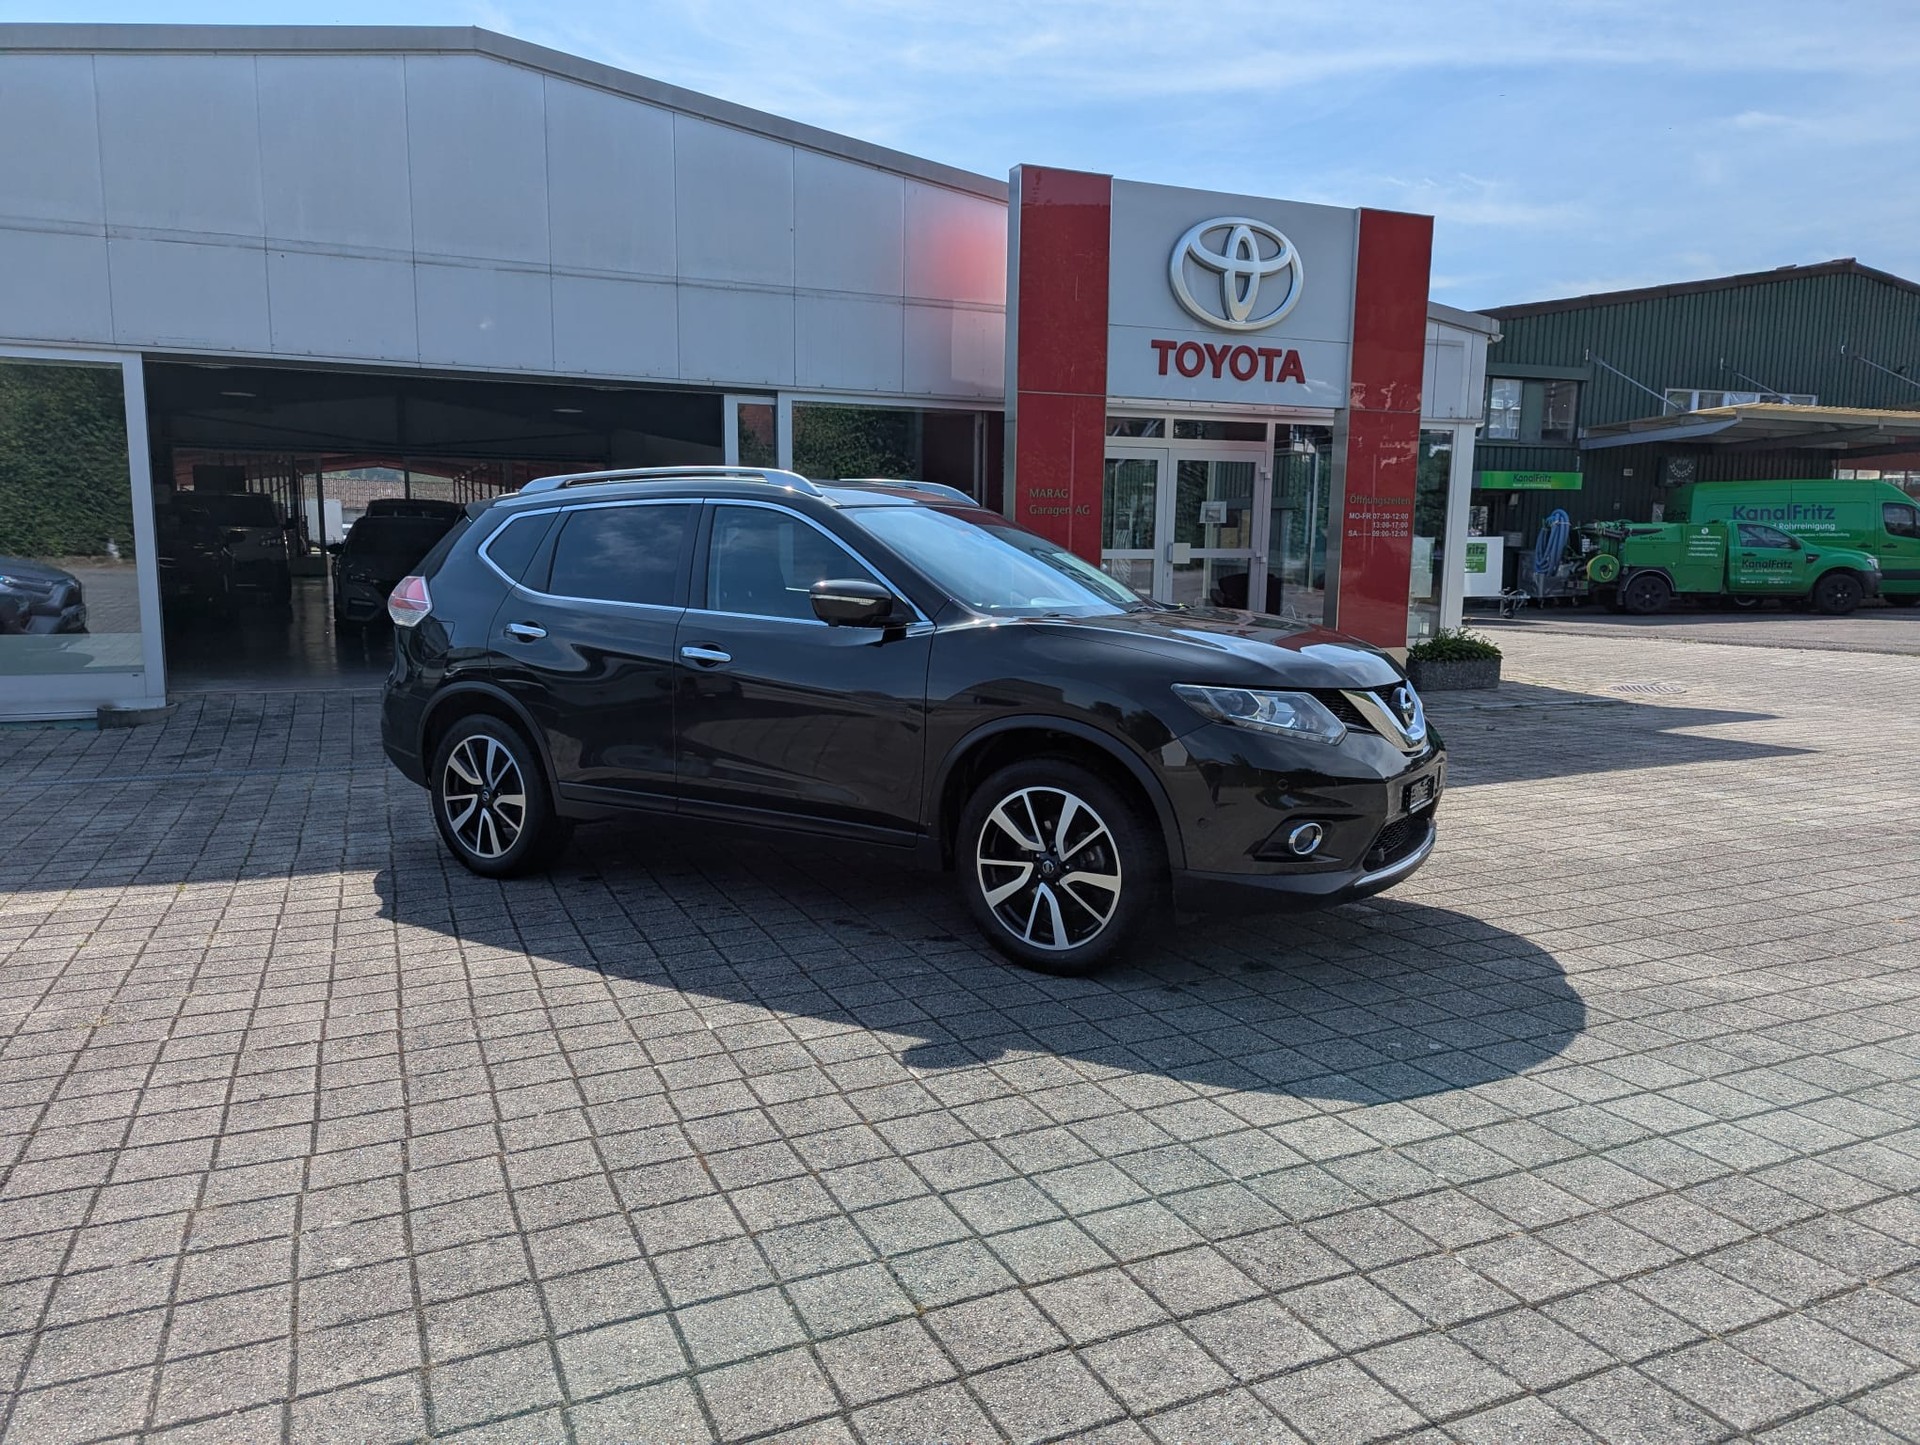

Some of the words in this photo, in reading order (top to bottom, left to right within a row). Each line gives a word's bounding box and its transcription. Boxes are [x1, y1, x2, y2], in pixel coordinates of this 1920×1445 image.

[1151, 339, 1306, 384] TOYOTA
[1512, 473, 1552, 483] KanalFritz
[1029, 488, 1069, 499] MARAG
[1029, 504, 1072, 518] Garagen
[1075, 504, 1090, 515] AG
[1349, 512, 1371, 520] MO-FR
[1732, 503, 1836, 521] KanalFritz
[1778, 522, 1836, 532] Rohrreinigung
[1742, 559, 1793, 569] KanalFritz
